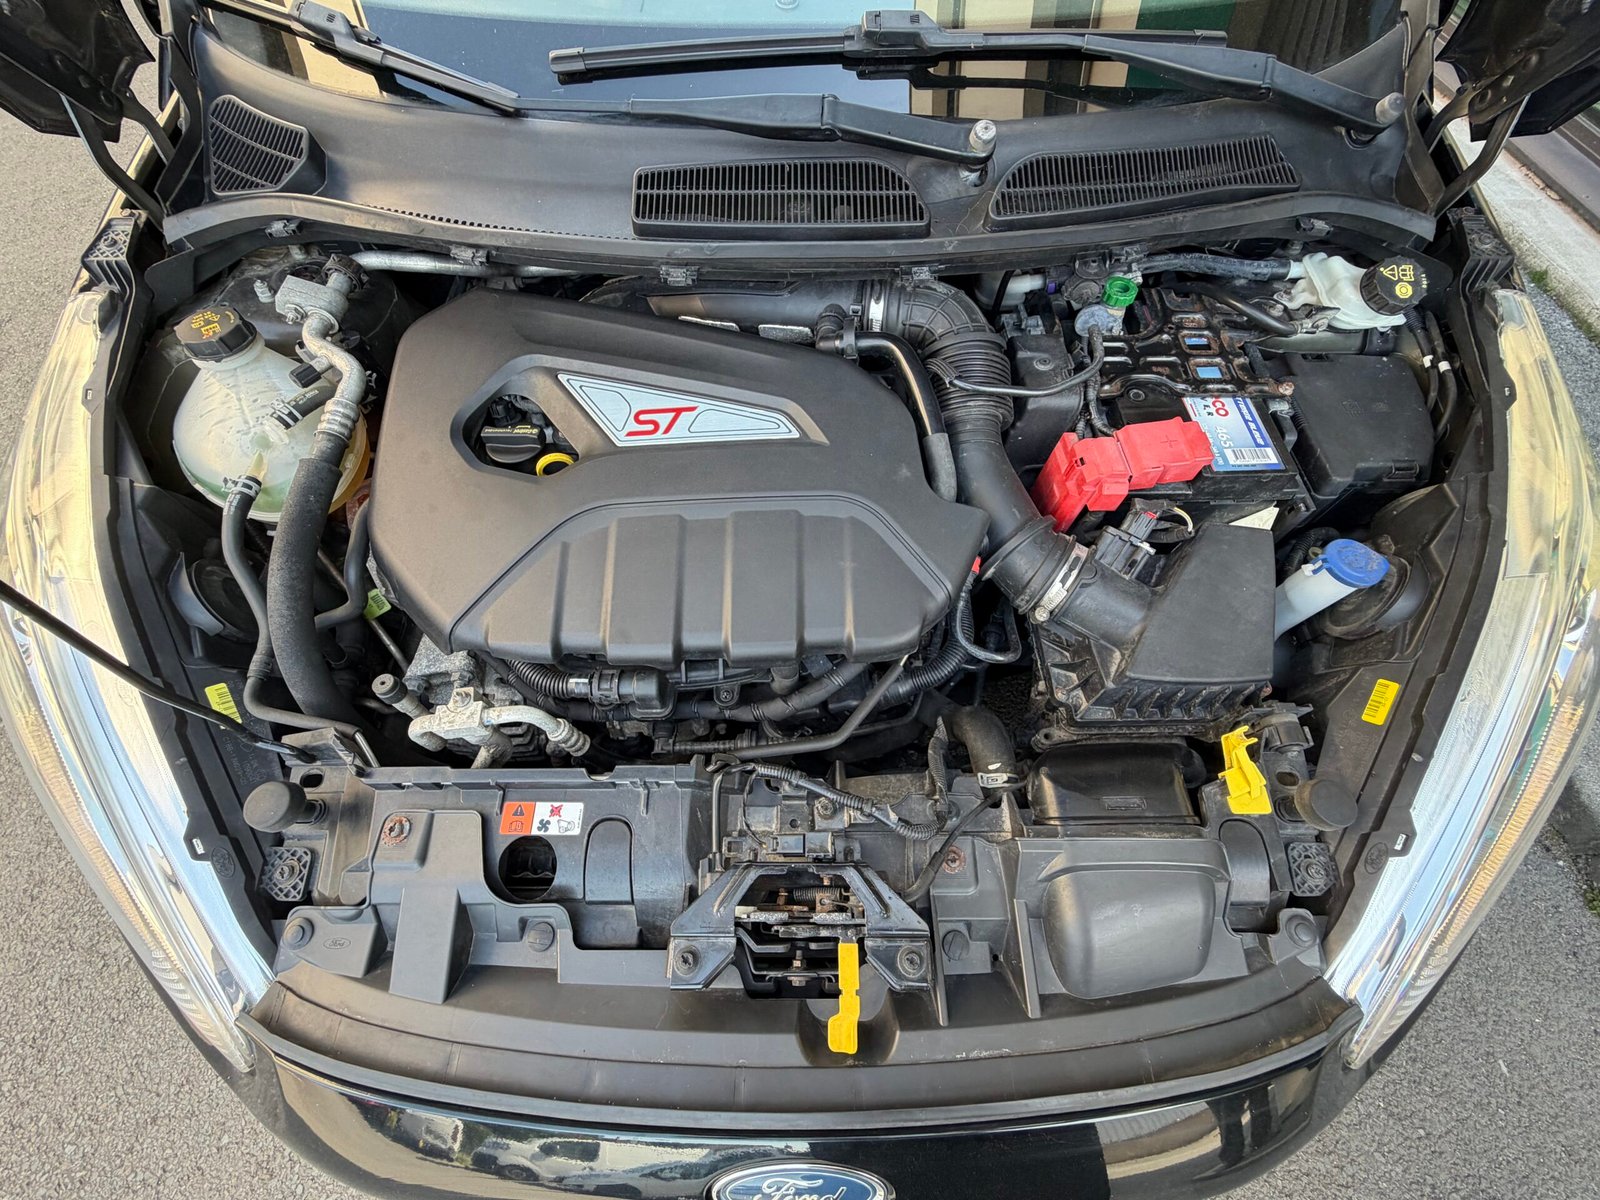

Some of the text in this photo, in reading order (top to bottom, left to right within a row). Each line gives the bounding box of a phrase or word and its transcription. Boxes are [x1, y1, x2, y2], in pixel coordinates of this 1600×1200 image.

[1211, 396, 1229, 417] CO
[624, 405, 699, 437] ST
[1214, 425, 1234, 448] 465
